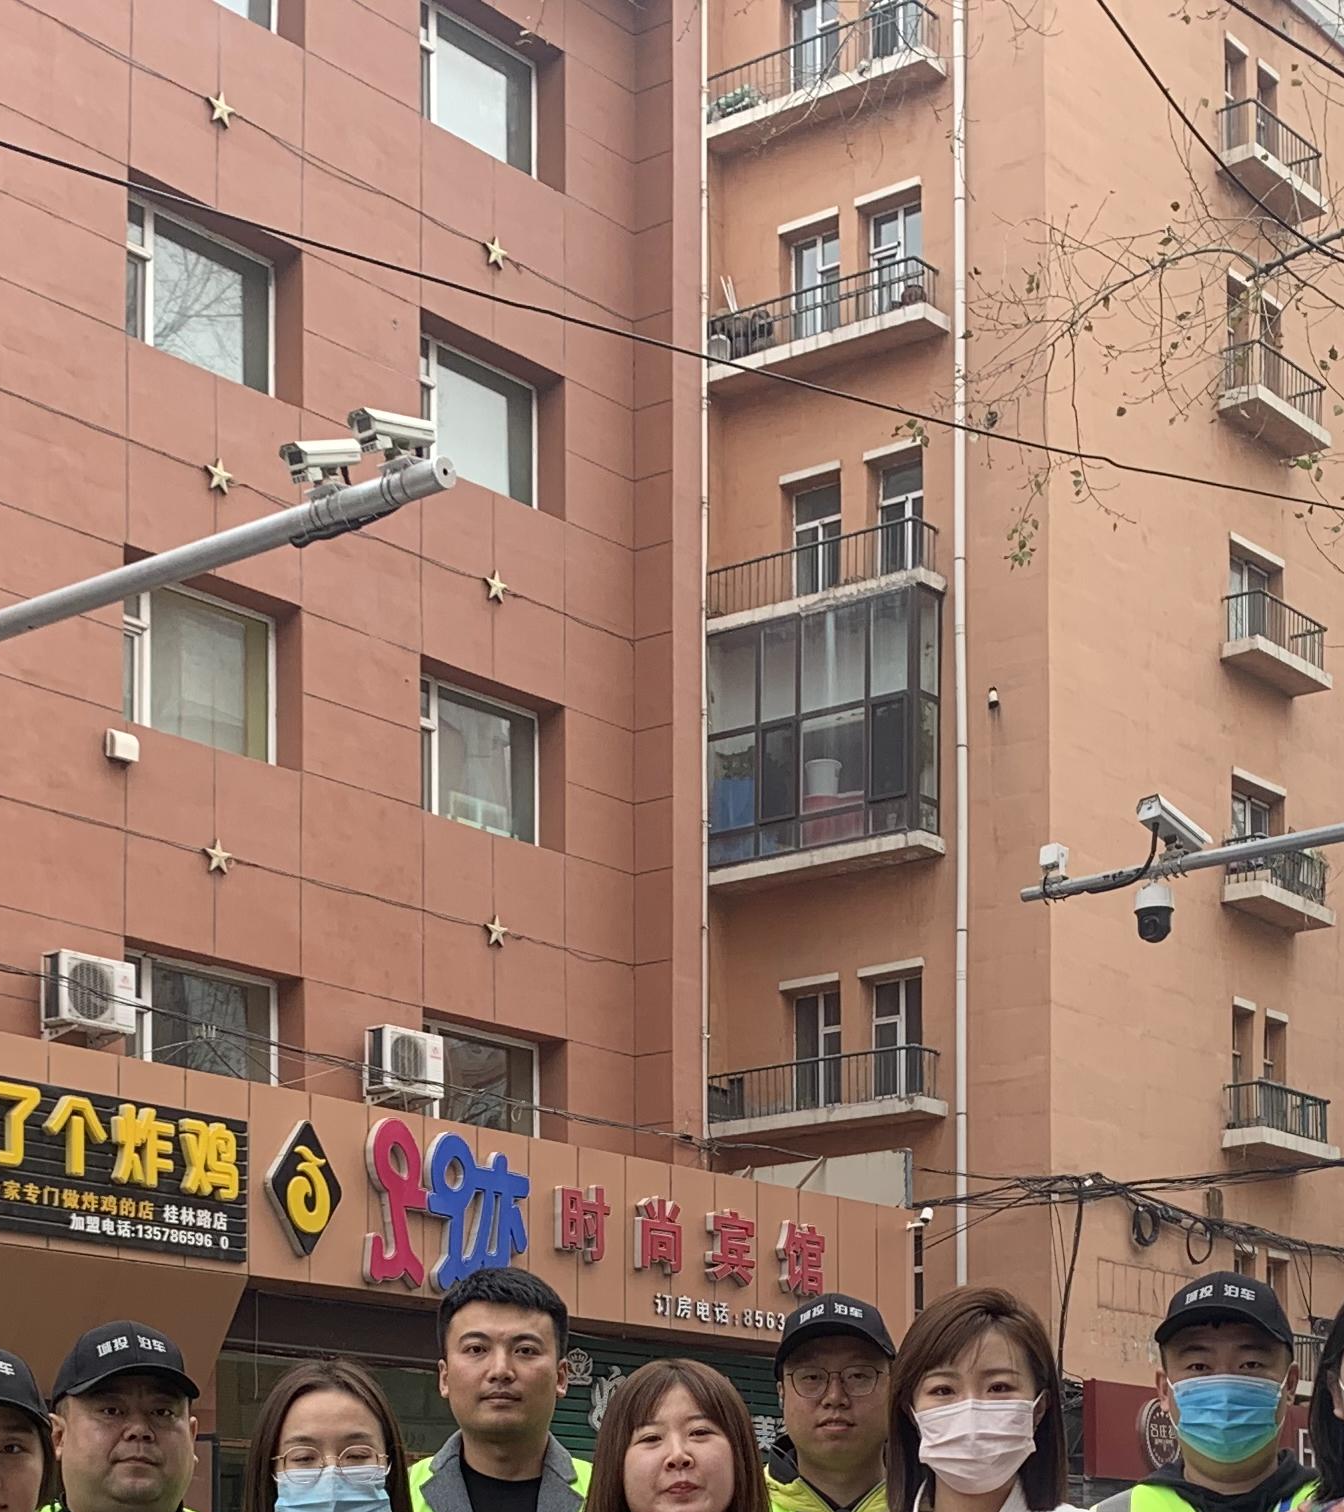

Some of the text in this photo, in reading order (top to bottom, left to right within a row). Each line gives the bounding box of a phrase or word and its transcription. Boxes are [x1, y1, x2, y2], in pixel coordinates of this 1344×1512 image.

[163, 1203, 229, 1231] 桂林路店
[554, 1184, 826, 1296] 时尚宾馆
[1223, 1283, 1256, 1302] 泊车
[654, 1292, 786, 1332] 订房电话:8563
[136, 1334, 167, 1353] 泊车
